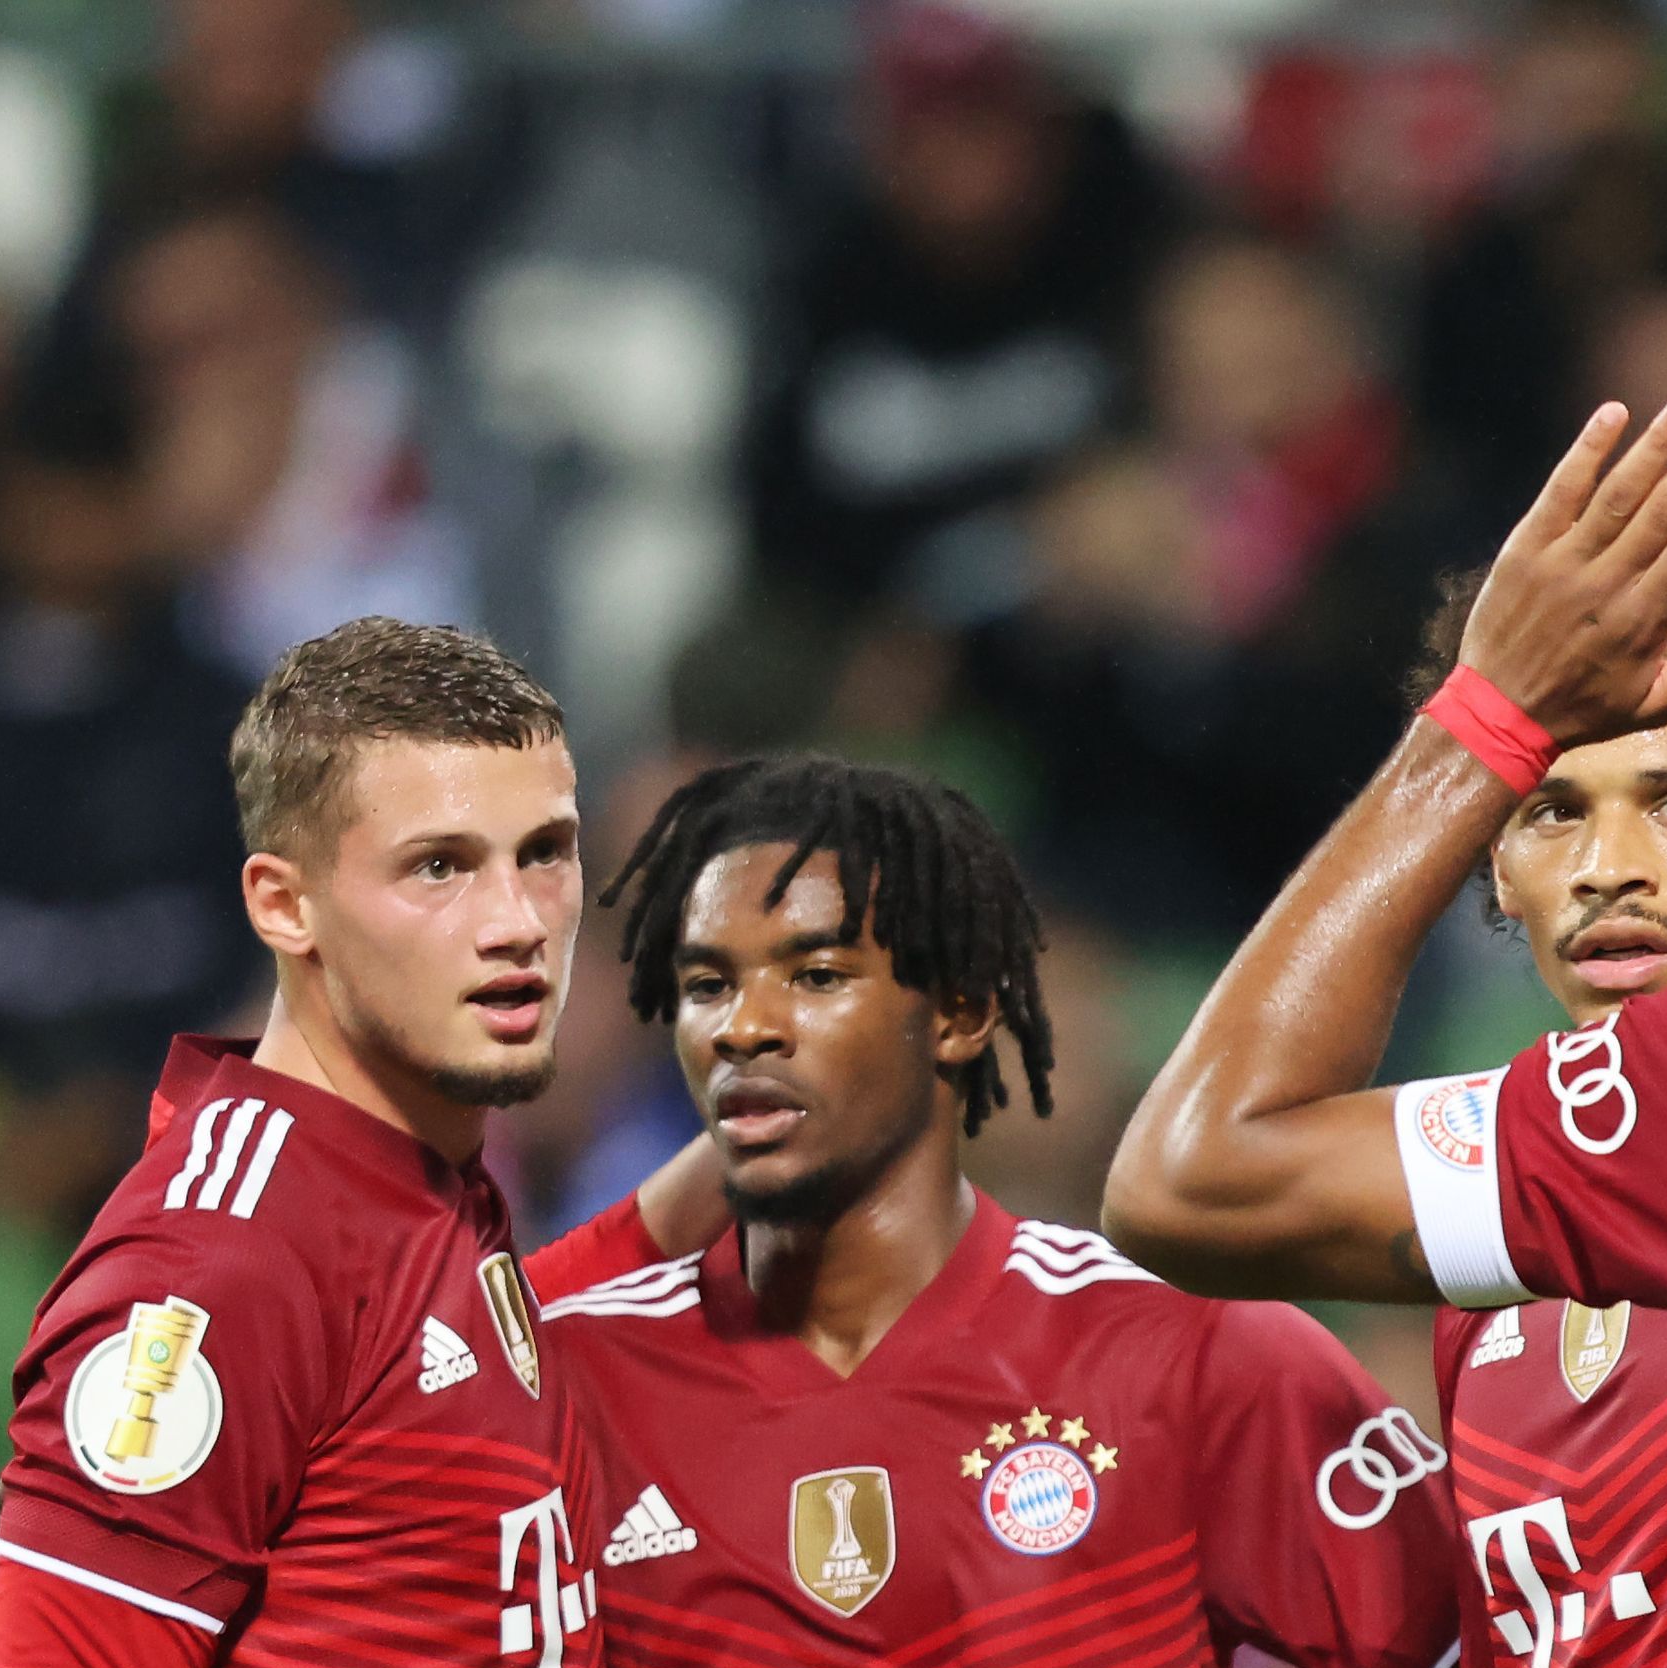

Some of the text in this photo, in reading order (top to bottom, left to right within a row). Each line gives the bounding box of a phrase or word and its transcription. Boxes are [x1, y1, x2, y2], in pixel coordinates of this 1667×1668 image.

[418, 1354, 478, 1394] adidas
[993, 1450, 1088, 1494] FC BAYERN
[603, 1526, 698, 1567] adidas
[821, 1557, 870, 1580] FIFA
